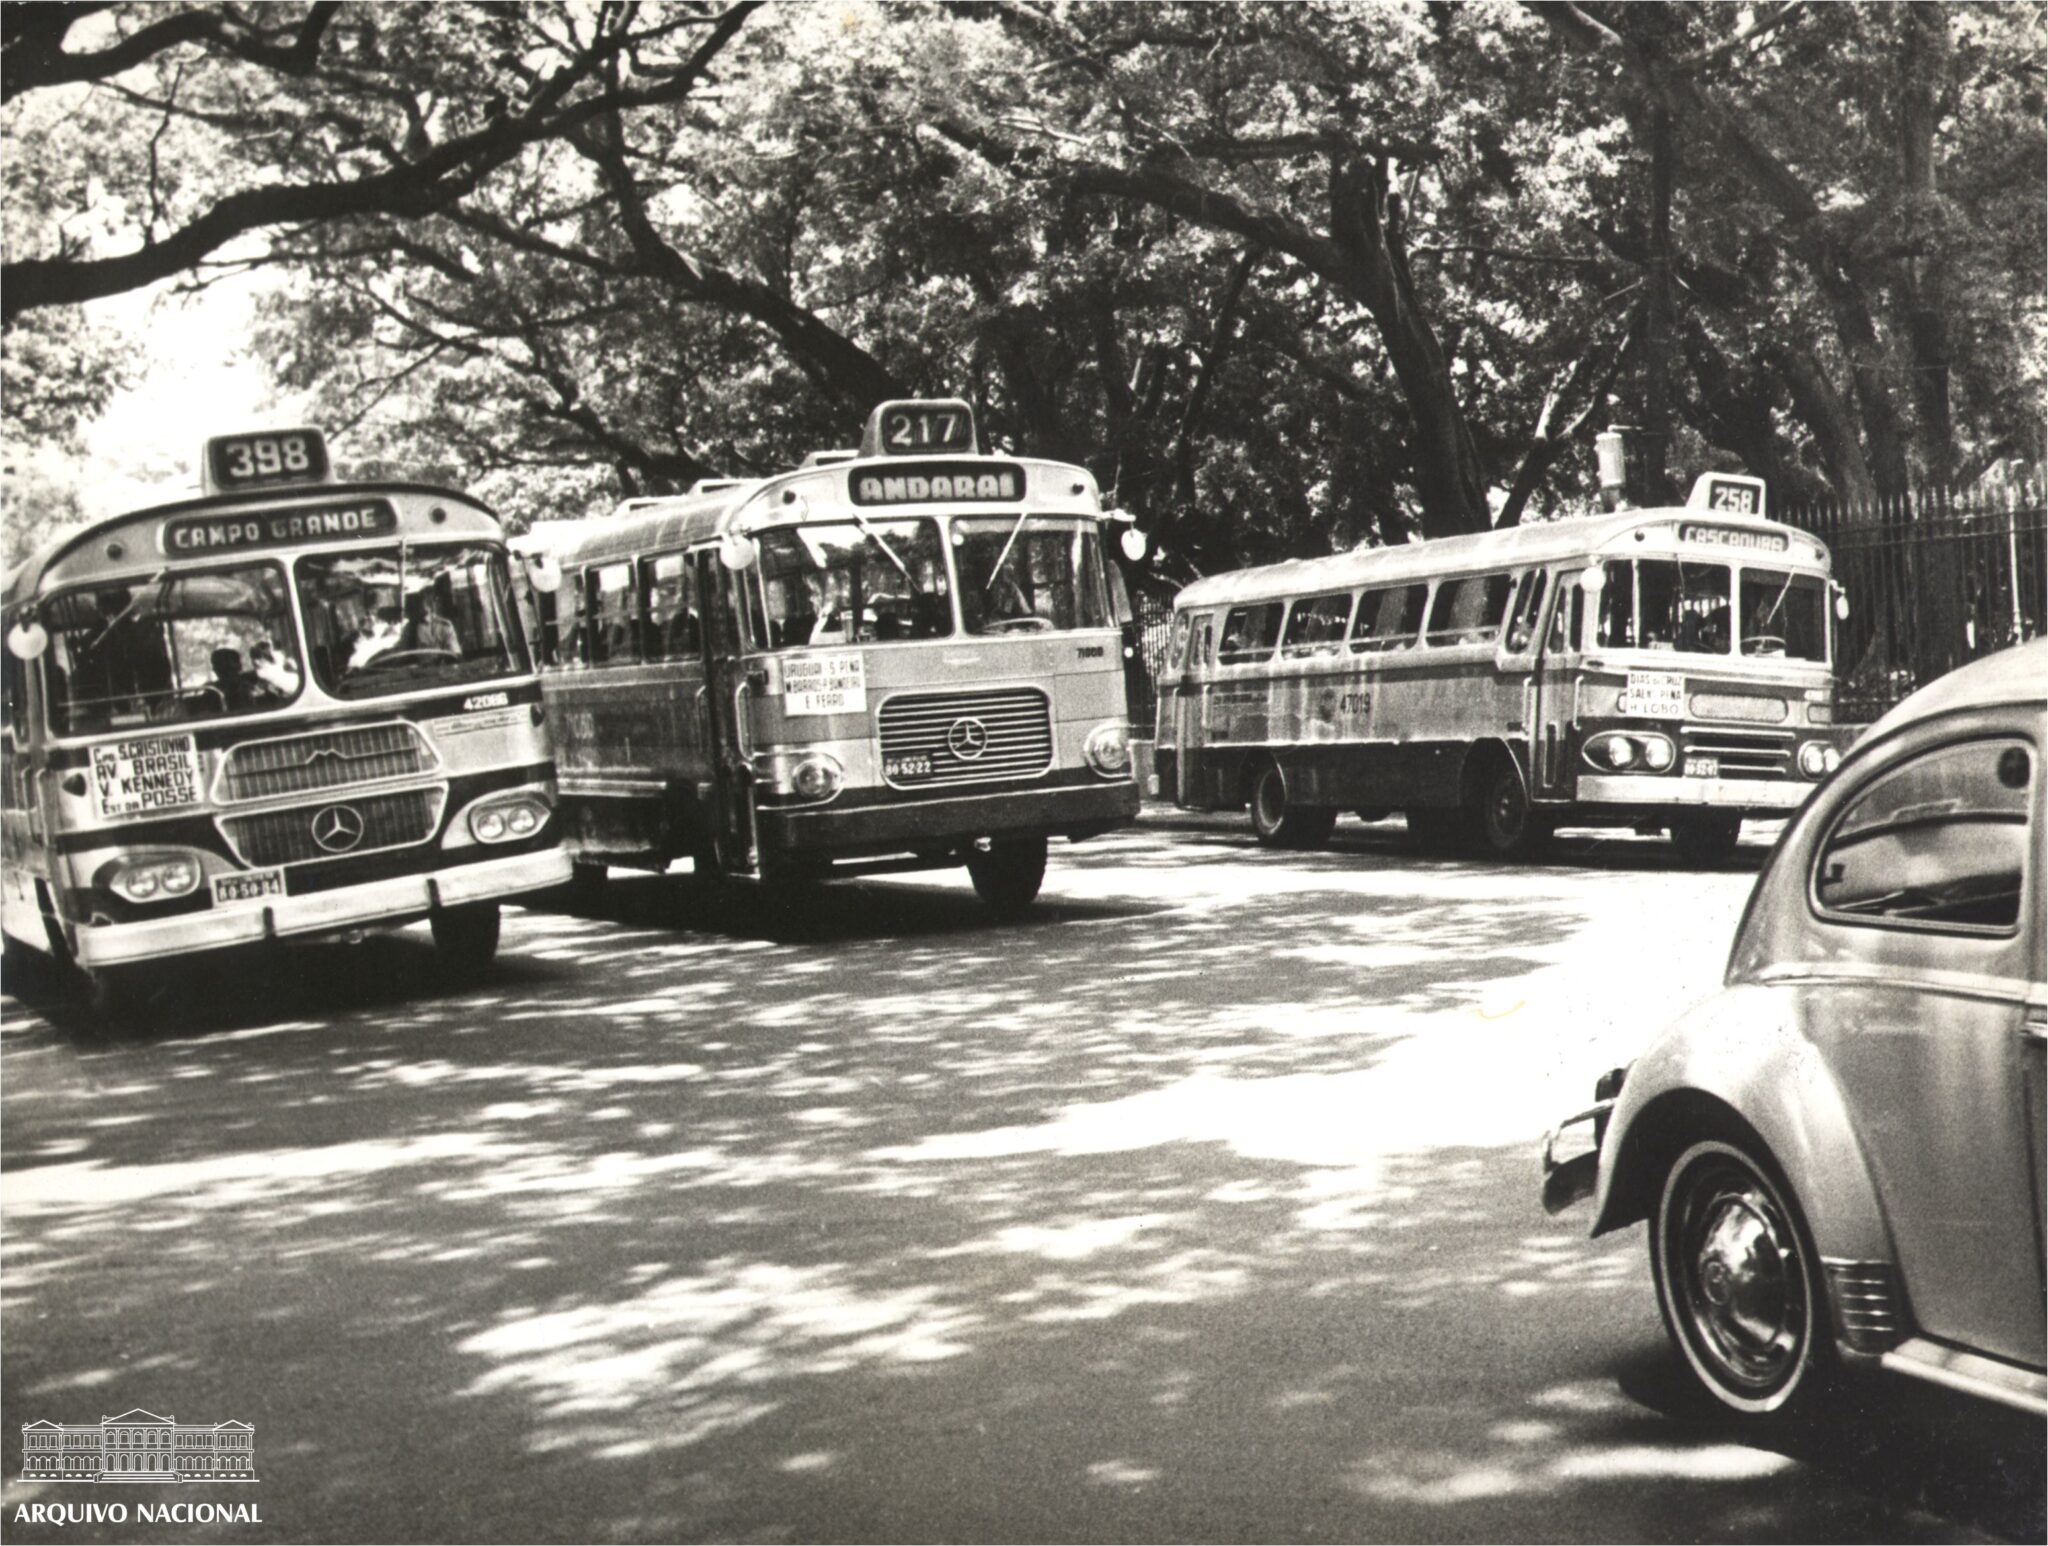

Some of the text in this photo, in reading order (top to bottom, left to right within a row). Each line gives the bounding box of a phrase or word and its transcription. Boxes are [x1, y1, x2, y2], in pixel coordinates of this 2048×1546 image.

[891, 414, 957, 446] 217
[226, 436, 309, 478] 398
[1714, 486, 1754, 514] 258
[174, 508, 376, 549] CAMPO GRANDE
[1630, 673, 1650, 685] DIAS
[1340, 692, 1371, 714] 47019
[1643, 703, 1679, 714] LOBO
[132, 754, 191, 776] BRASIL
[121, 769, 193, 794] KENNEDY
[141, 785, 197, 808] POSSE
